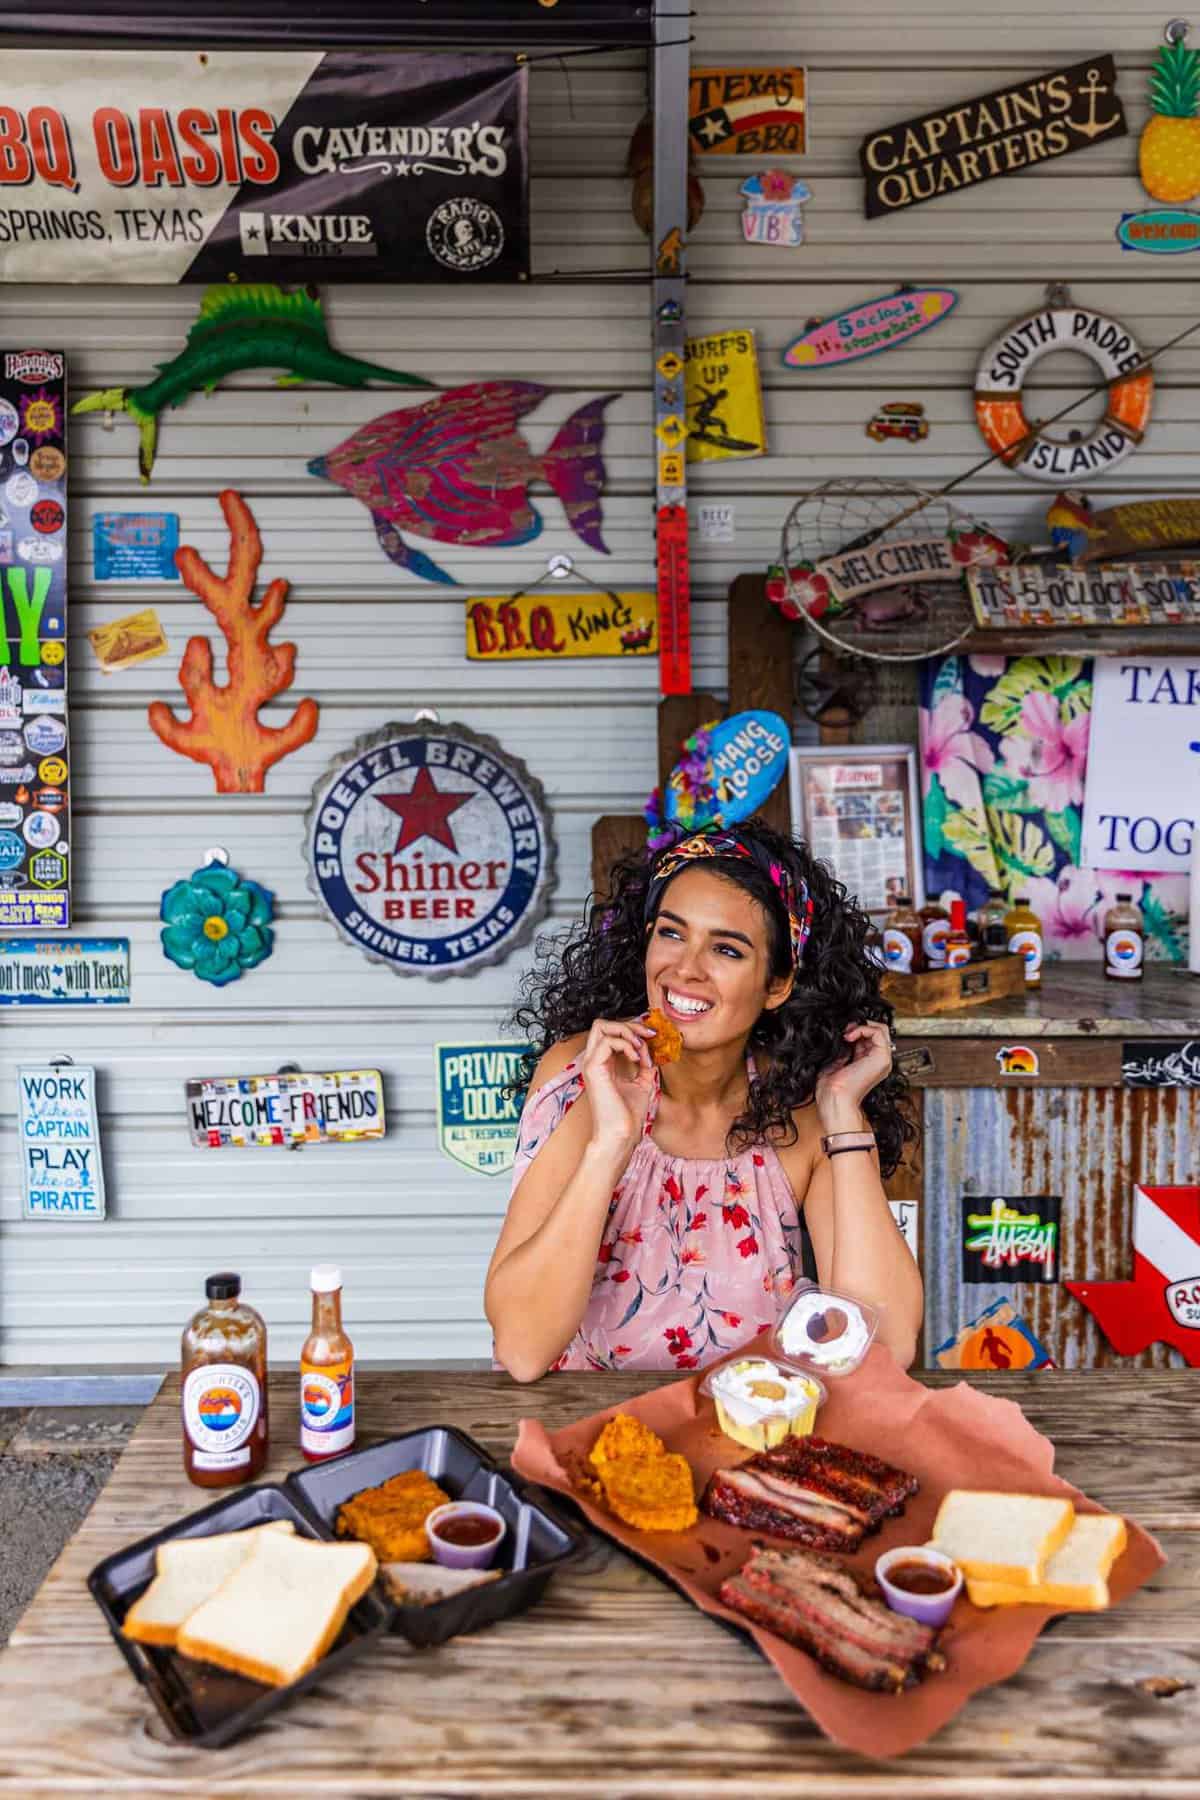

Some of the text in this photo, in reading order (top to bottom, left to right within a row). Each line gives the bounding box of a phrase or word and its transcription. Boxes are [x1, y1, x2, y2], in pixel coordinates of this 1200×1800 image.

[689, 74, 793, 108] TEXAS
[736, 123, 799, 154] BBQ
[865, 74, 1072, 174] CAPTAIN'S
[92, 107, 280, 187] OASIS
[292, 122, 508, 177] CAVENDER'S
[877, 120, 1068, 208] QUARTERS
[116, 209, 204, 242] TEXAS
[270, 214, 373, 242] KNUE
[438, 201, 490, 224] RADIO
[838, 318, 854, 337] 5
[991, 312, 1143, 387] SOUTH PADRE
[703, 364, 730, 384] UP
[1025, 431, 1126, 474] ISLAND
[827, 542, 951, 589] WELCOME
[567, 607, 632, 641] KING
[713, 719, 768, 773] HANG
[724, 728, 785, 800] LOOSE
[317, 742, 538, 879] SPOETZL BREWERY
[354, 852, 507, 893] Shiner
[384, 898, 477, 920] BEER
[344, 906, 514, 962] SHINER, TEXAS
[23, 963, 50, 990] mess
[64, 960, 90, 990] with
[93, 960, 125, 989] Texas
[444, 1051, 527, 1091] PRIVAT
[23, 1077, 86, 1100] WORK
[463, 1087, 518, 1120] DOCK
[24, 1120, 89, 1137] CAPTAIN
[28, 1147, 90, 1169] PLAY
[478, 1151, 505, 1165] BAIT
[30, 1190, 96, 1210] PIRATE
